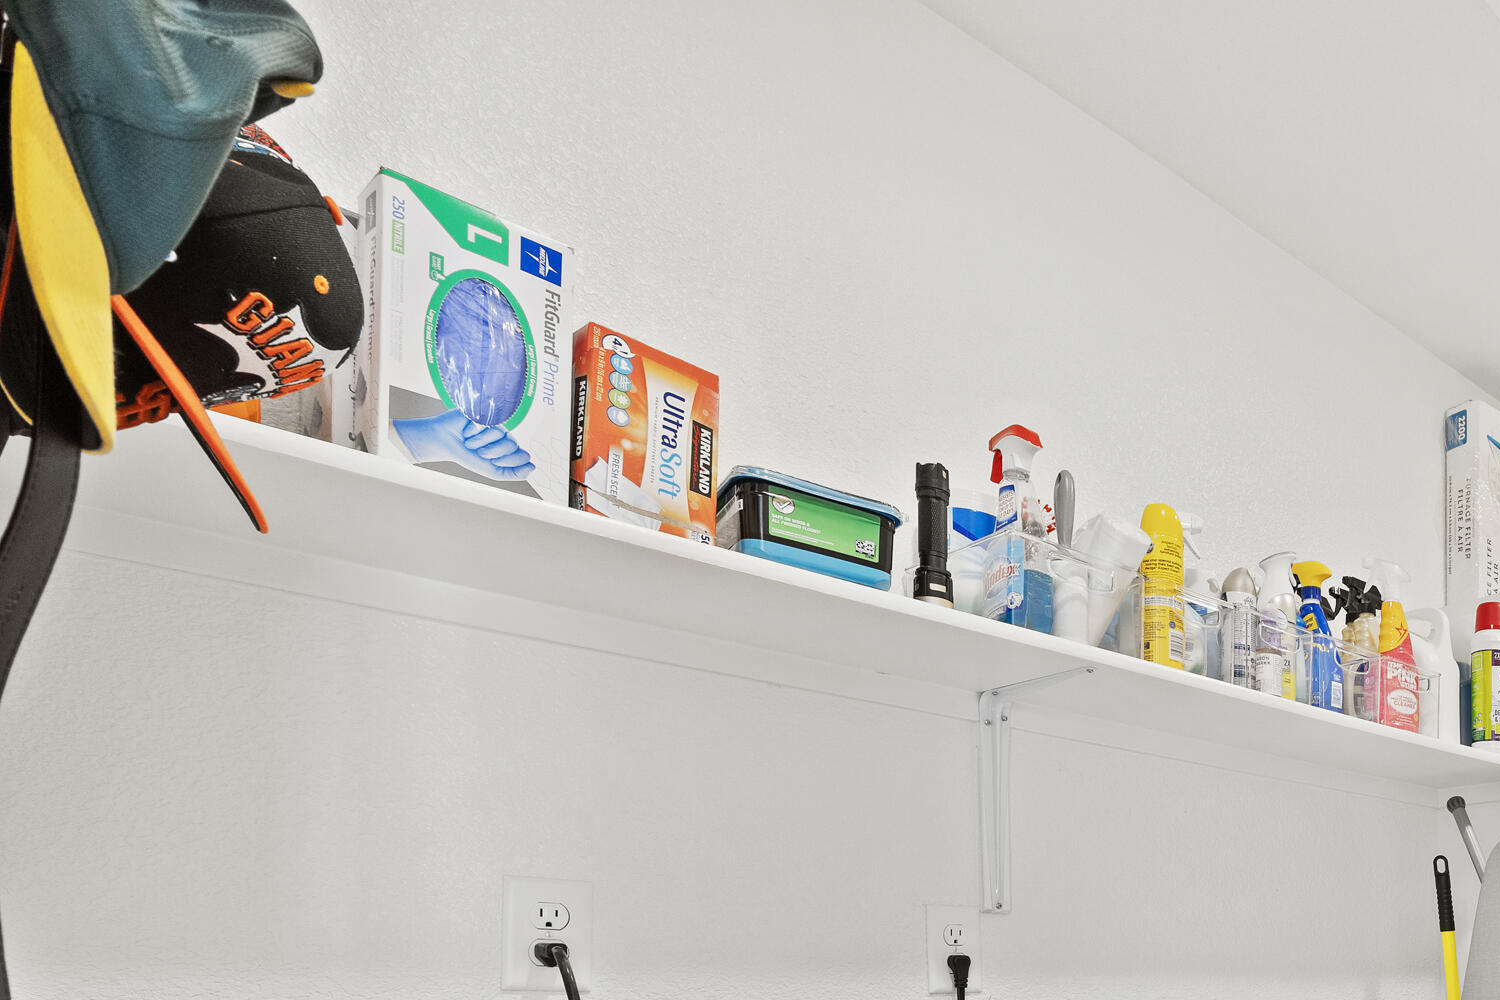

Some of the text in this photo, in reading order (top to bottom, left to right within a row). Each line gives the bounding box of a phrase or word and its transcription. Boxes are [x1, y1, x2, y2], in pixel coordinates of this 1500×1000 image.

[392, 195, 405, 220] 250
[392, 221, 405, 254] NITRILE
[467, 223, 502, 244] L
[612, 338, 622, 346] 4
[542, 360, 560, 406] Prime
[575, 380, 586, 457] KIRKLAND
[1458, 416, 1466, 440] 2200
[611, 453, 622, 478] FRESH
[698, 430, 712, 494] KIRKLAND
[1464, 478, 1472, 560] FURNACE FILTER
